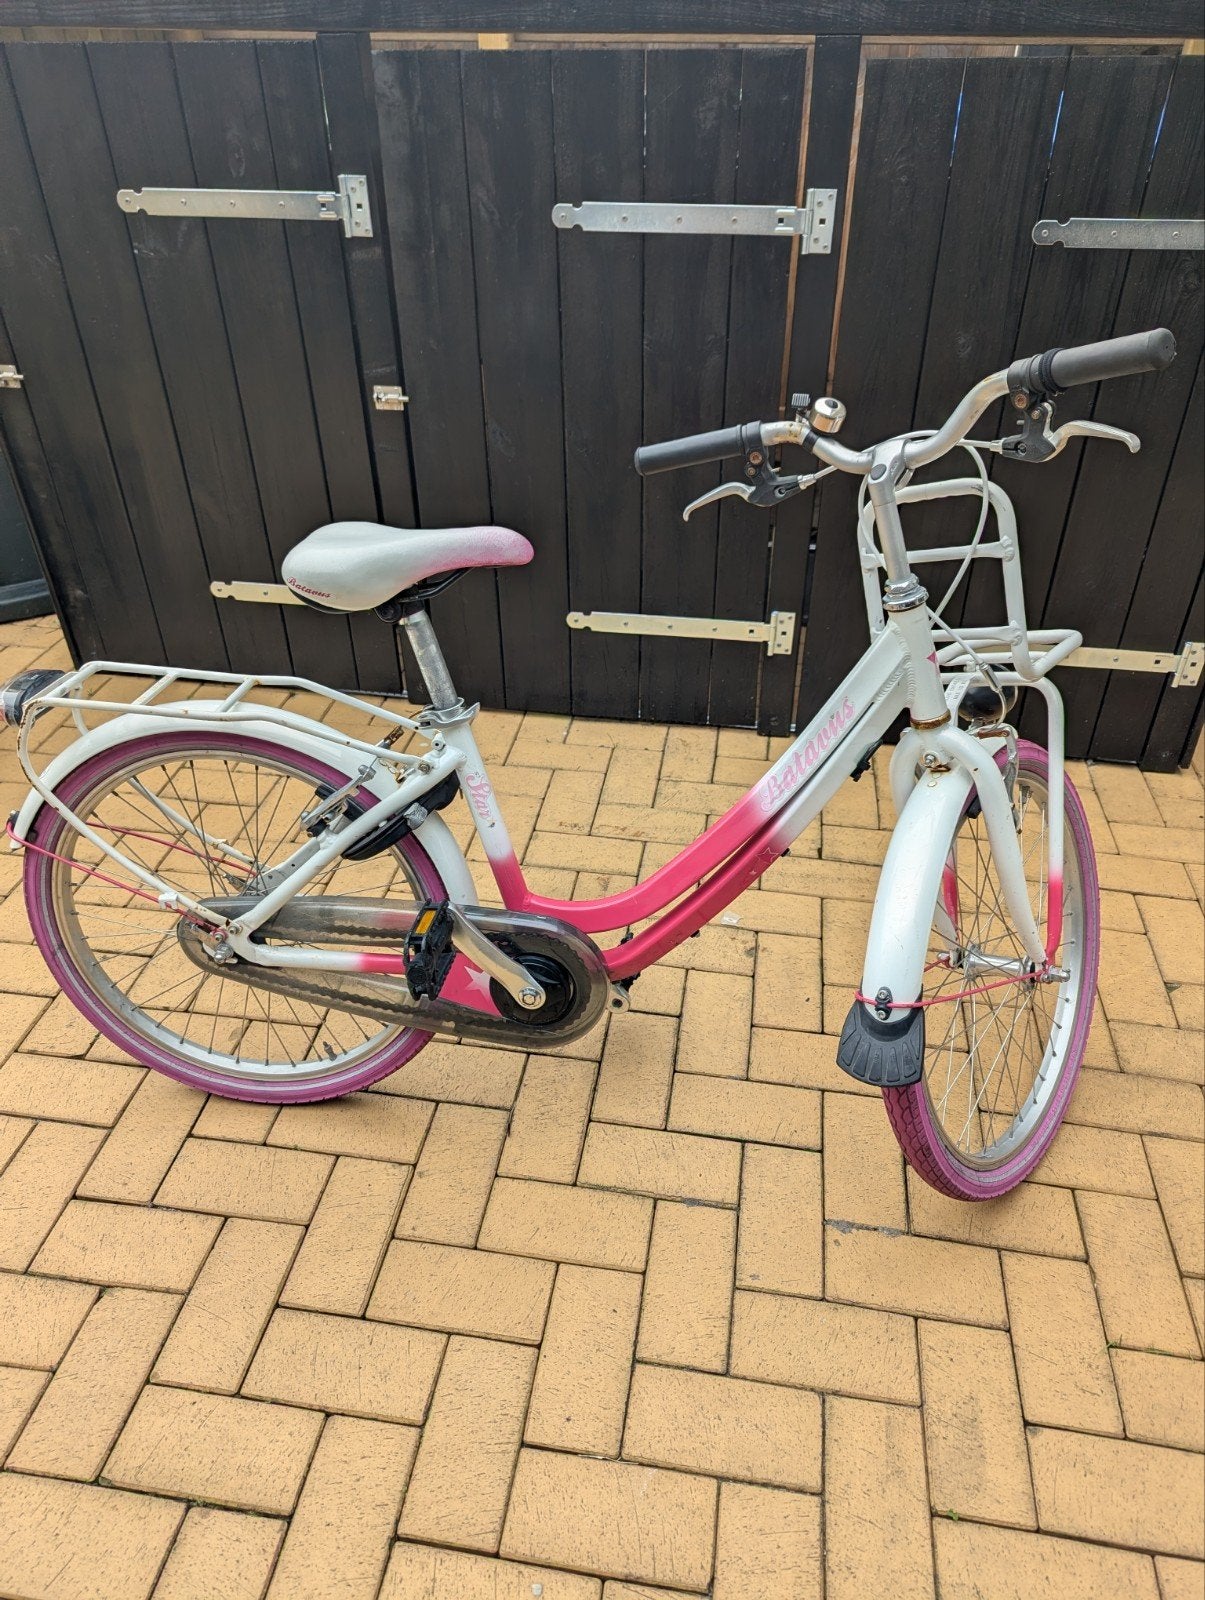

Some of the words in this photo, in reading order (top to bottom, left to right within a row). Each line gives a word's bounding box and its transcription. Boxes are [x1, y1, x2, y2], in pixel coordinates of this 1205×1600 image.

[287, 577, 331, 598] Batavus
[760, 697, 855, 811] Batavus
[465, 773, 491, 819] Star
